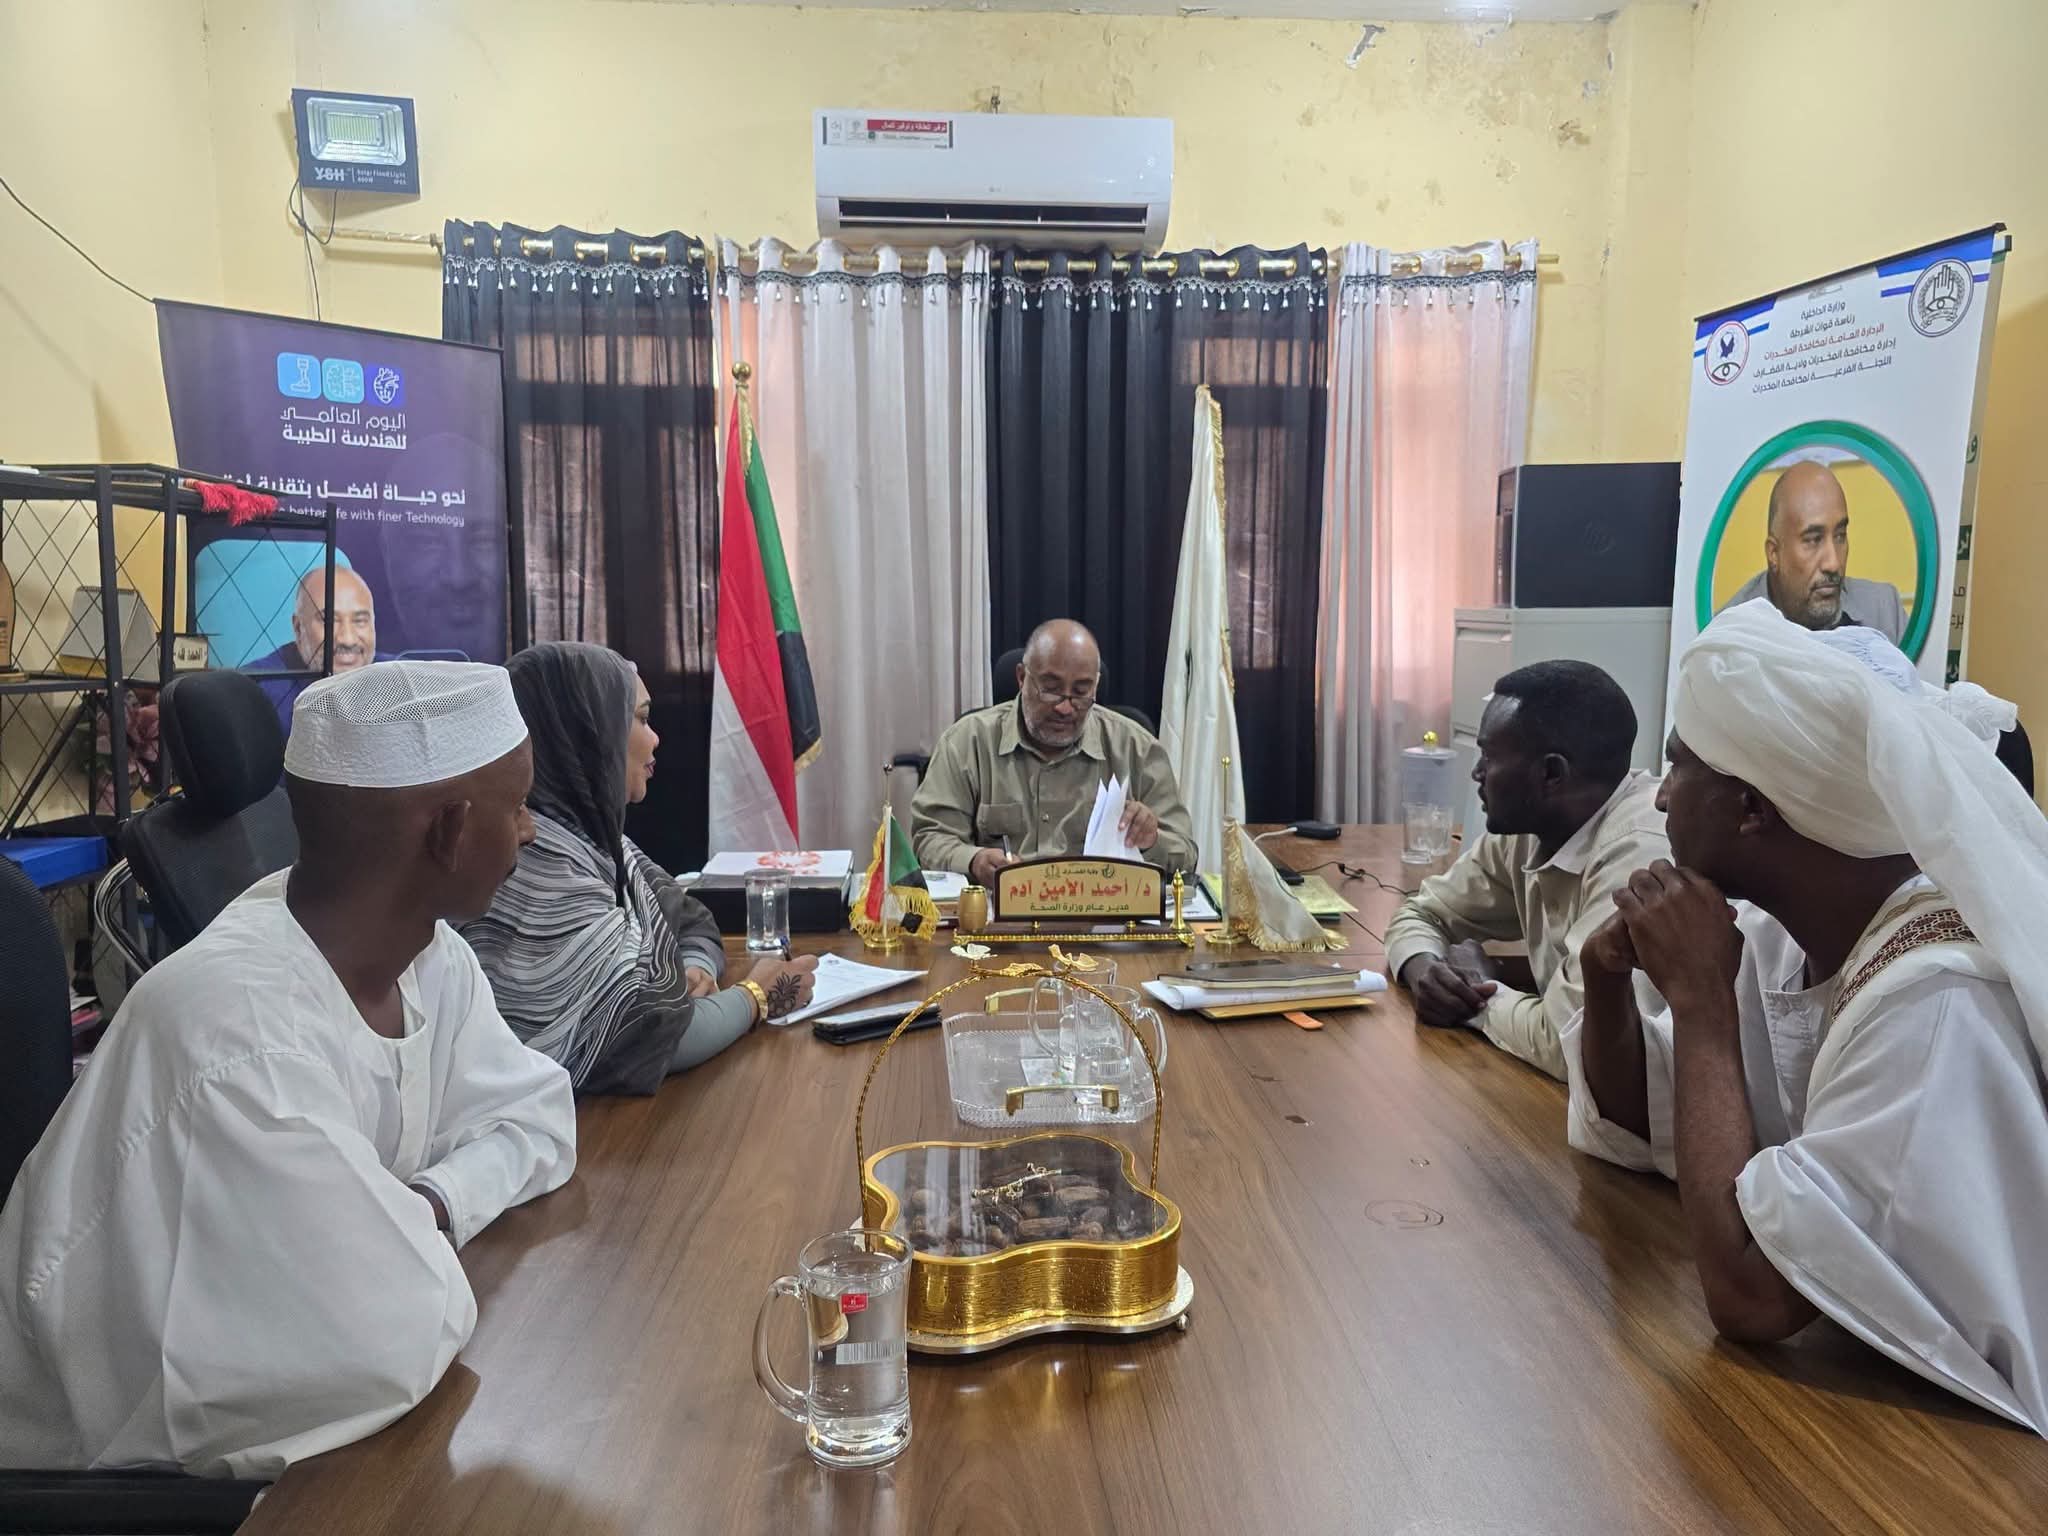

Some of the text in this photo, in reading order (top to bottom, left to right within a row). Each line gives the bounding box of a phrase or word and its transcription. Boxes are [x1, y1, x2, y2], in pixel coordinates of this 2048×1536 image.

[1801, 301, 1846, 320] وزارة الداخلية
[1790, 325, 1814, 339] الشرطة
[1815, 320, 1833, 332] قوات
[1798, 338, 1828, 353] لمكافحة
[1844, 342, 1876, 358] مكافحة
[1877, 337, 1896, 350] إدارة
[1764, 344, 1797, 361] المخدرات
[1808, 350, 1842, 367] المخدرات
[1781, 373, 1810, 387] لمكافحة
[280, 406, 406, 431] اليوم العالمي
[282, 423, 407, 450] للهندسة الطبية
[383, 483, 437, 506] حياة
[441, 489, 466, 507] نحو
[350, 509, 375, 521] with
[378, 510, 402, 522] finer
[406, 512, 464, 528] Technology
[1039, 878, 1084, 900] الأمين
[1030, 902, 1129, 912] مدير عام وزارة الصحة
